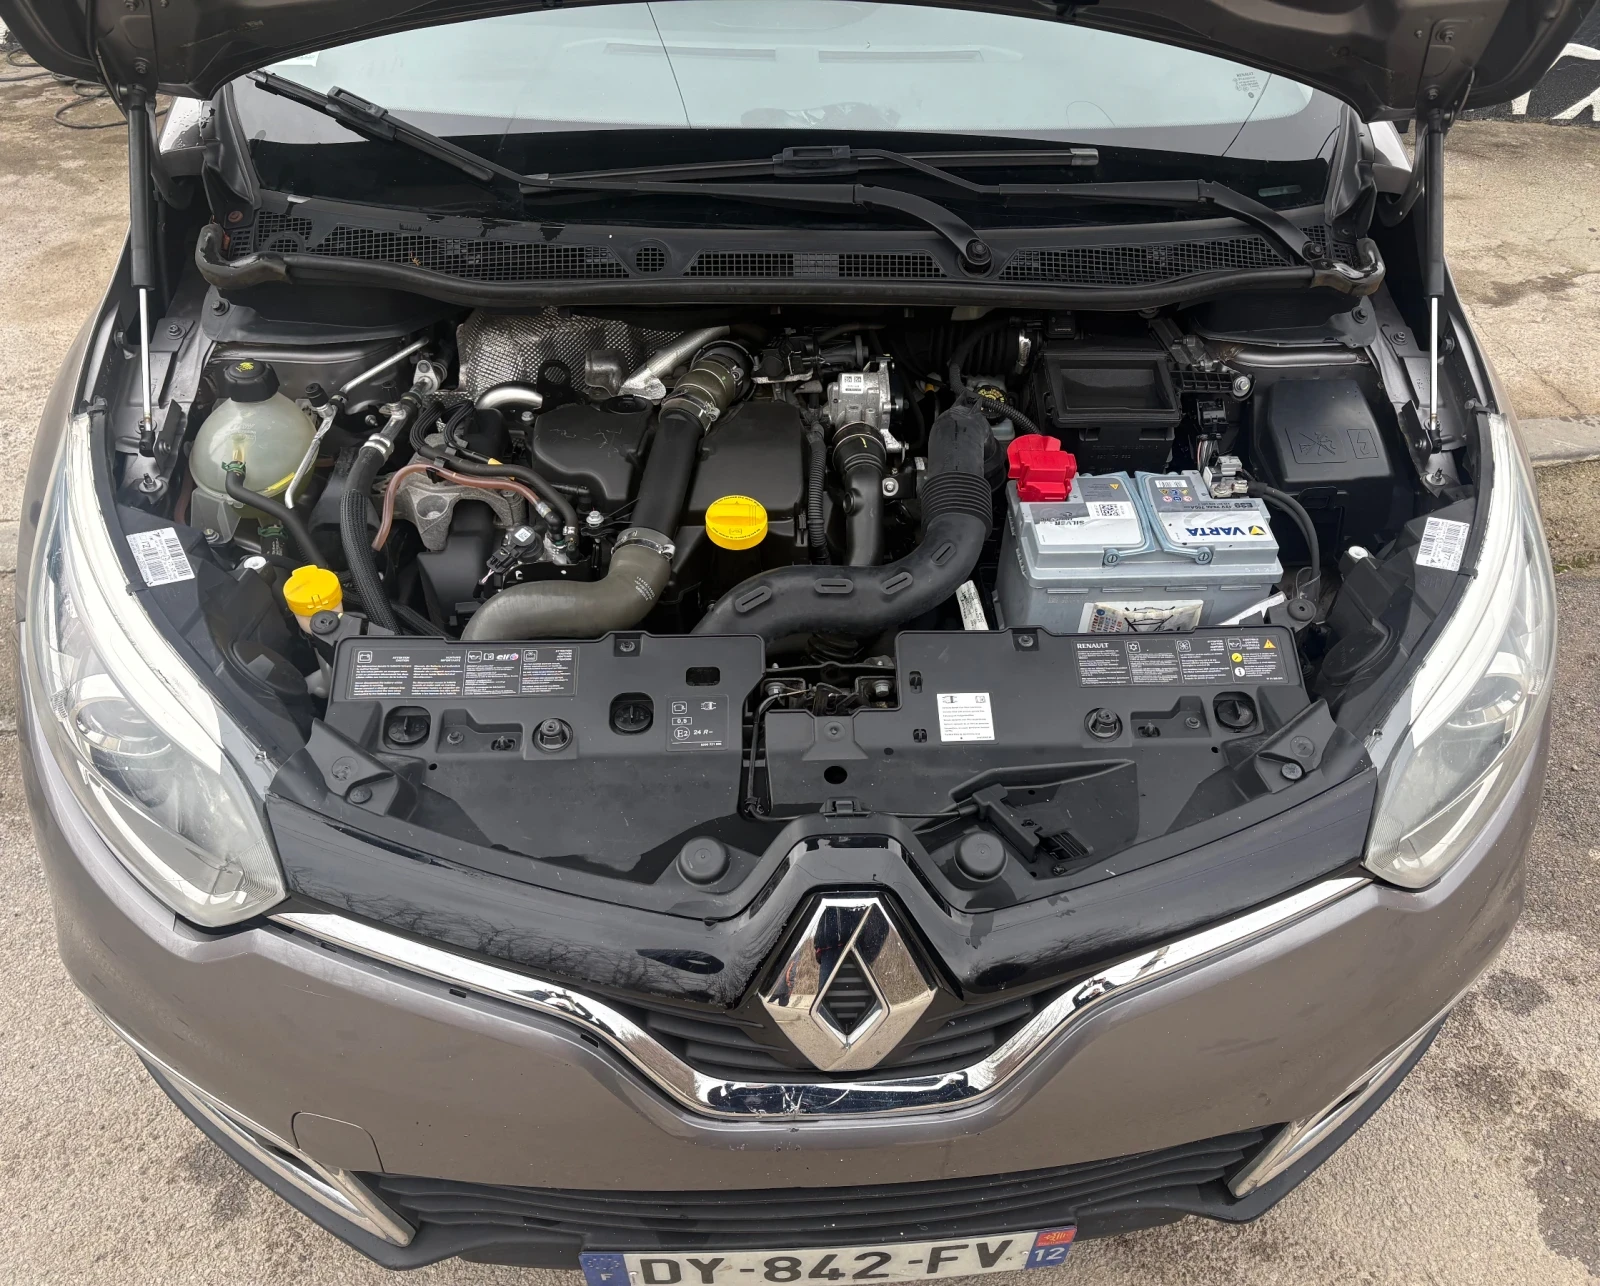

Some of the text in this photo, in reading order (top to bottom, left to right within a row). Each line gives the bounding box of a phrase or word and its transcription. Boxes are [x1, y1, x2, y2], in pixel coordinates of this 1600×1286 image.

[1185, 527, 1246, 536] VARTA
[677, 729, 689, 738] E2
[1035, 1247, 1065, 1262] 12
[640, 1240, 1013, 1285] DY-842-FV
[600, 1273, 613, 1281] F
